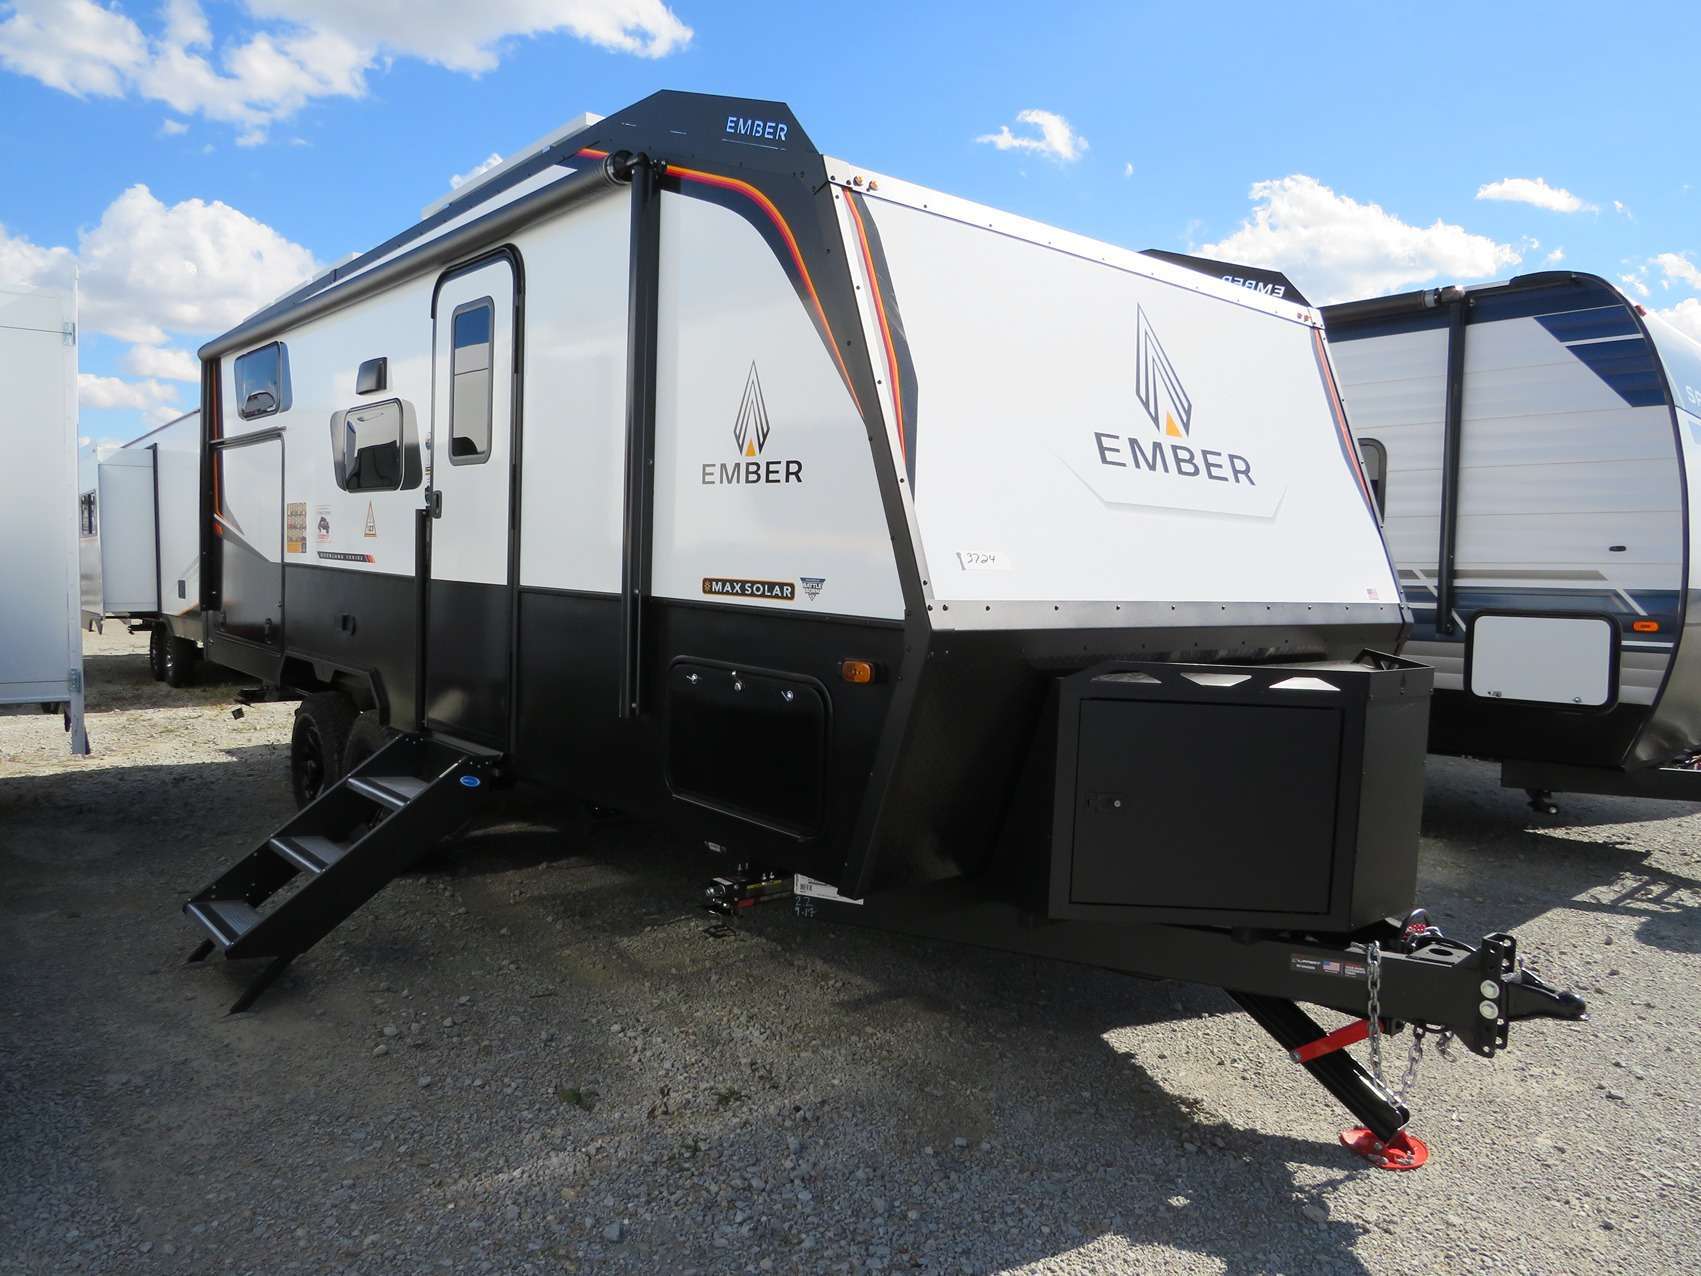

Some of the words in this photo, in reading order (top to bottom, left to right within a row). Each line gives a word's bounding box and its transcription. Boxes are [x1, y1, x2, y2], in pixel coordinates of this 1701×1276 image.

[726, 116, 788, 141] EMBER
[1094, 431, 1256, 486] EMBER
[702, 460, 803, 485] EMBER
[712, 581, 742, 594] MAX
[744, 583, 792, 598] SOLAR
